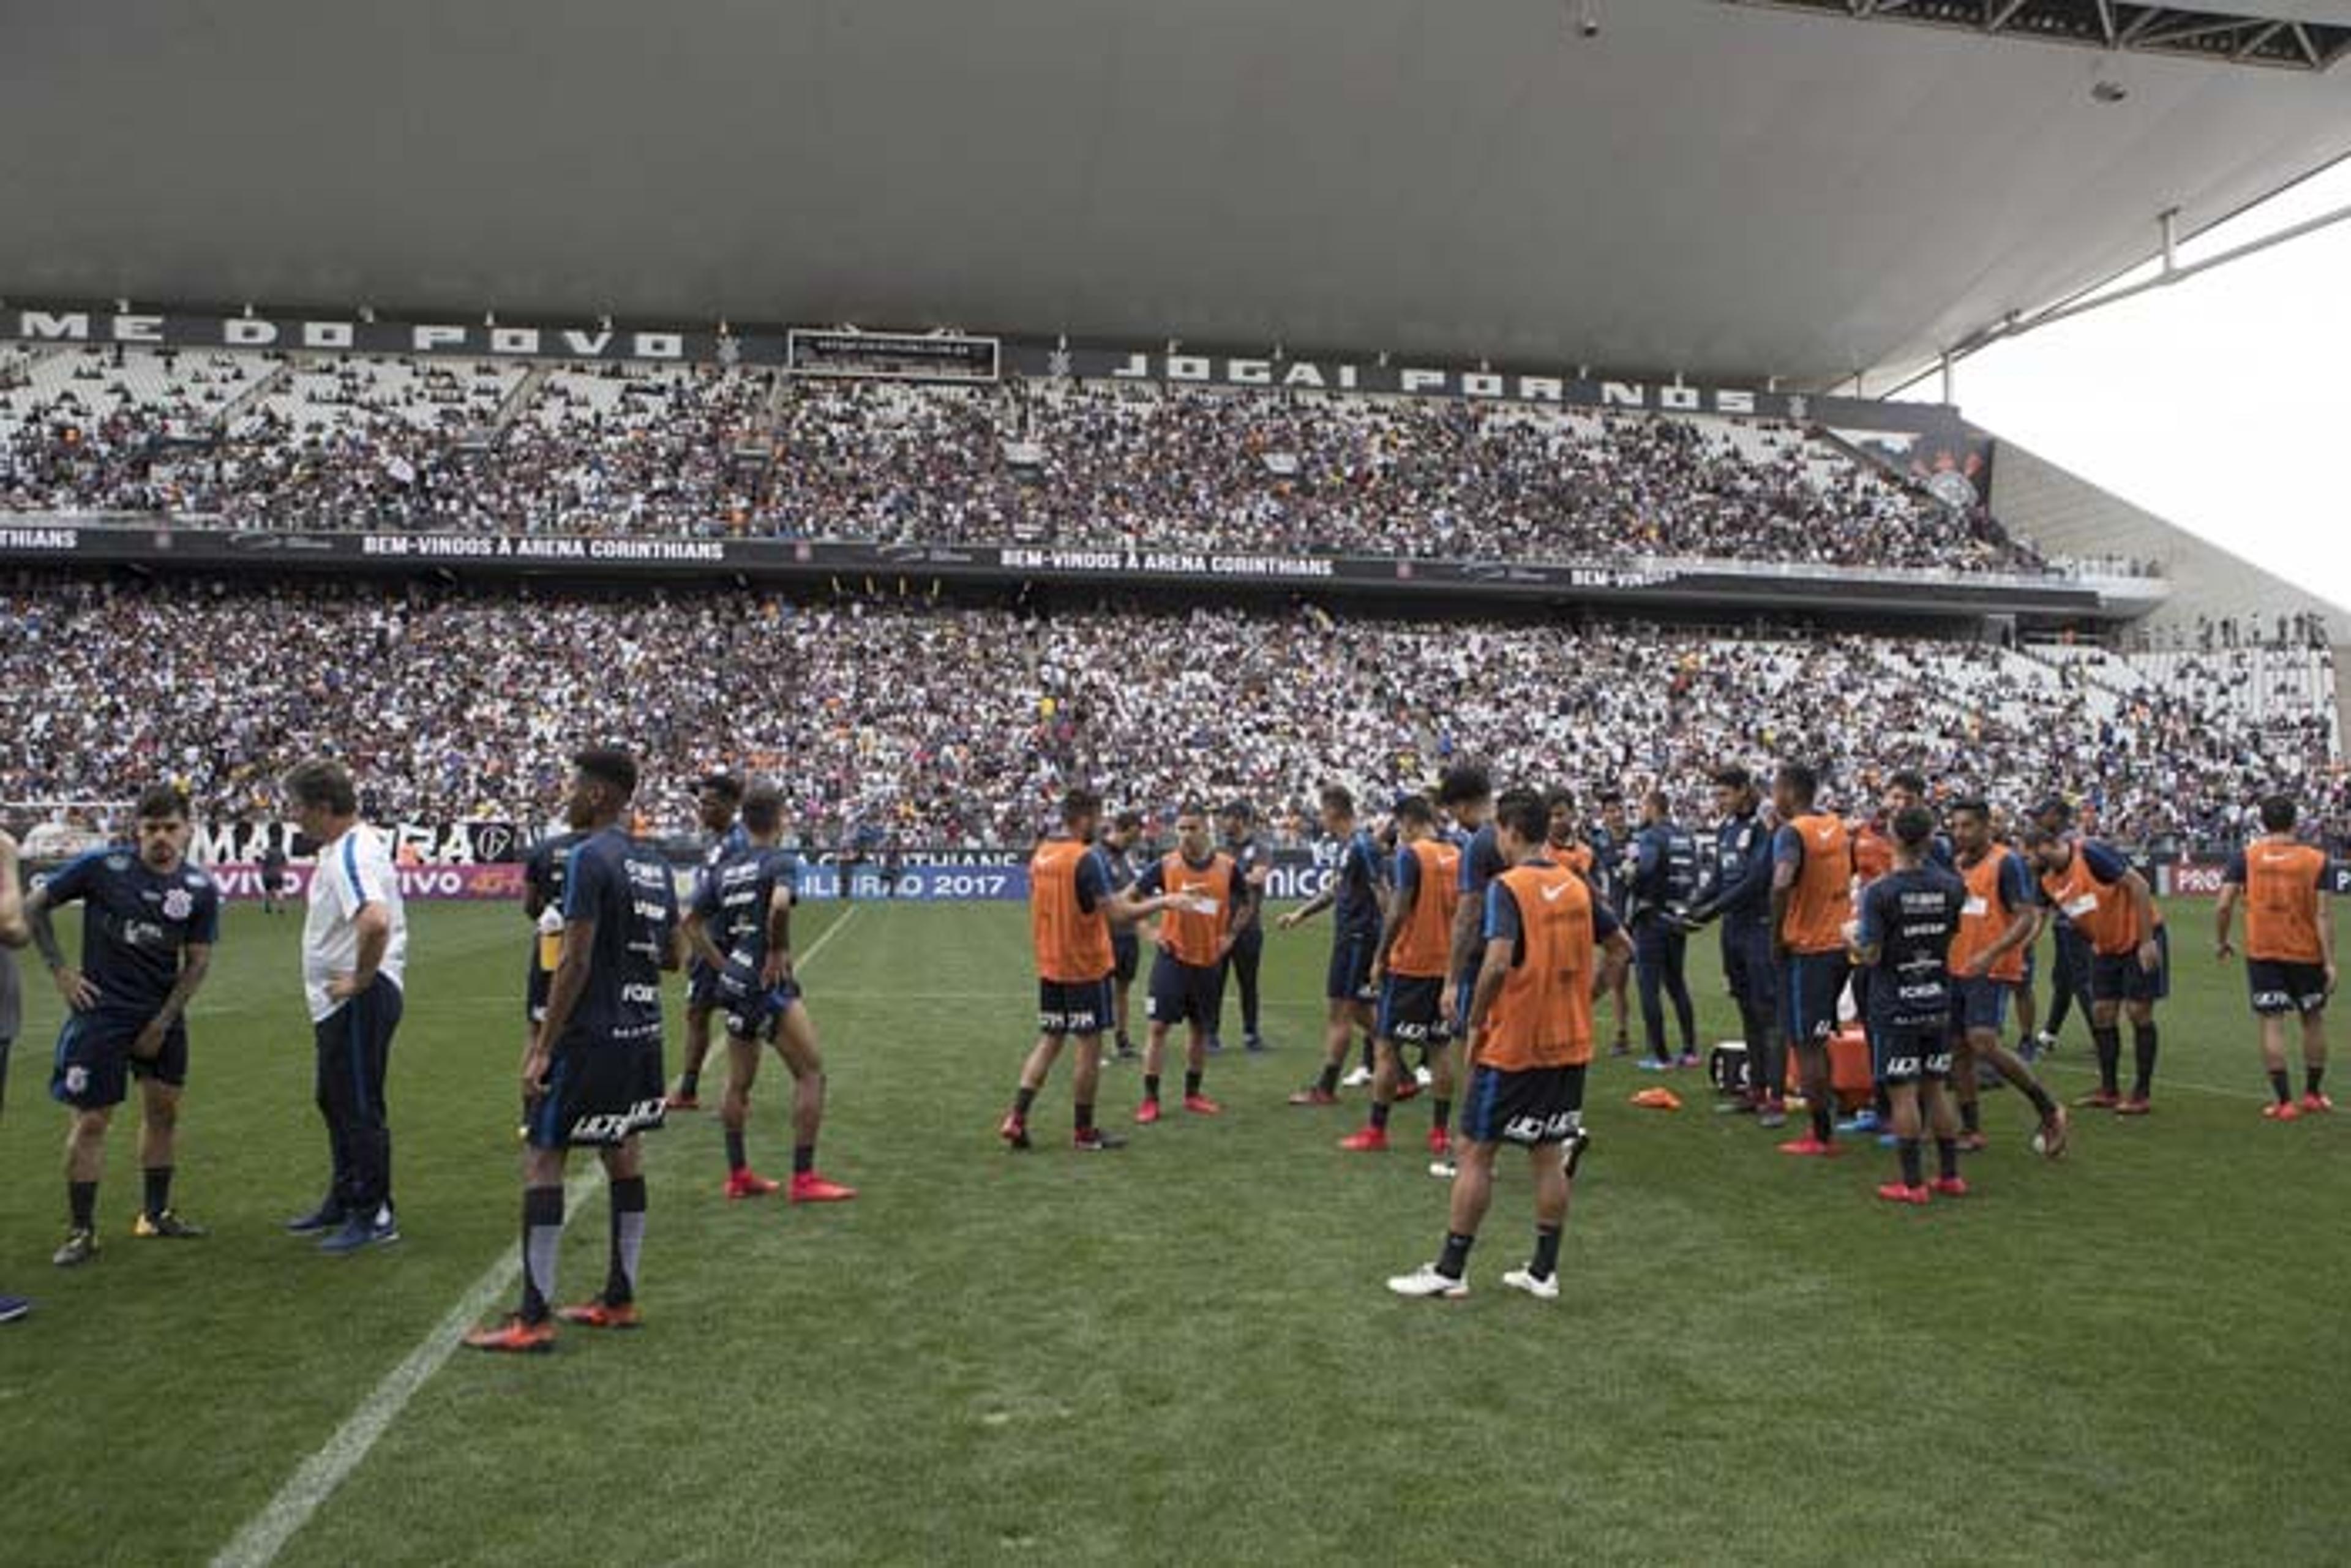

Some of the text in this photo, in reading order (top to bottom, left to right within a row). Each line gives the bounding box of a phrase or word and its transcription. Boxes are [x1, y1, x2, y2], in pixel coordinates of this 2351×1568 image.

[21, 311, 163, 341] ME
[224, 318, 353, 347] DO
[413, 325, 683, 358] POVO
[1114, 353, 1357, 388] JOGAI
[1402, 369, 1562, 399] POR
[364, 536, 491, 555] BEM-VINDOS
[517, 539, 585, 557] ARENA
[591, 541, 724, 560] CORINTHIANS
[1000, 550, 1120, 569] BEM-VINDOS
[1145, 552, 1206, 571] ARENA
[1212, 554, 1332, 576] CORINTHIANS
[933, 875, 1006, 896] 2017
[2178, 868, 2225, 891] PRO
